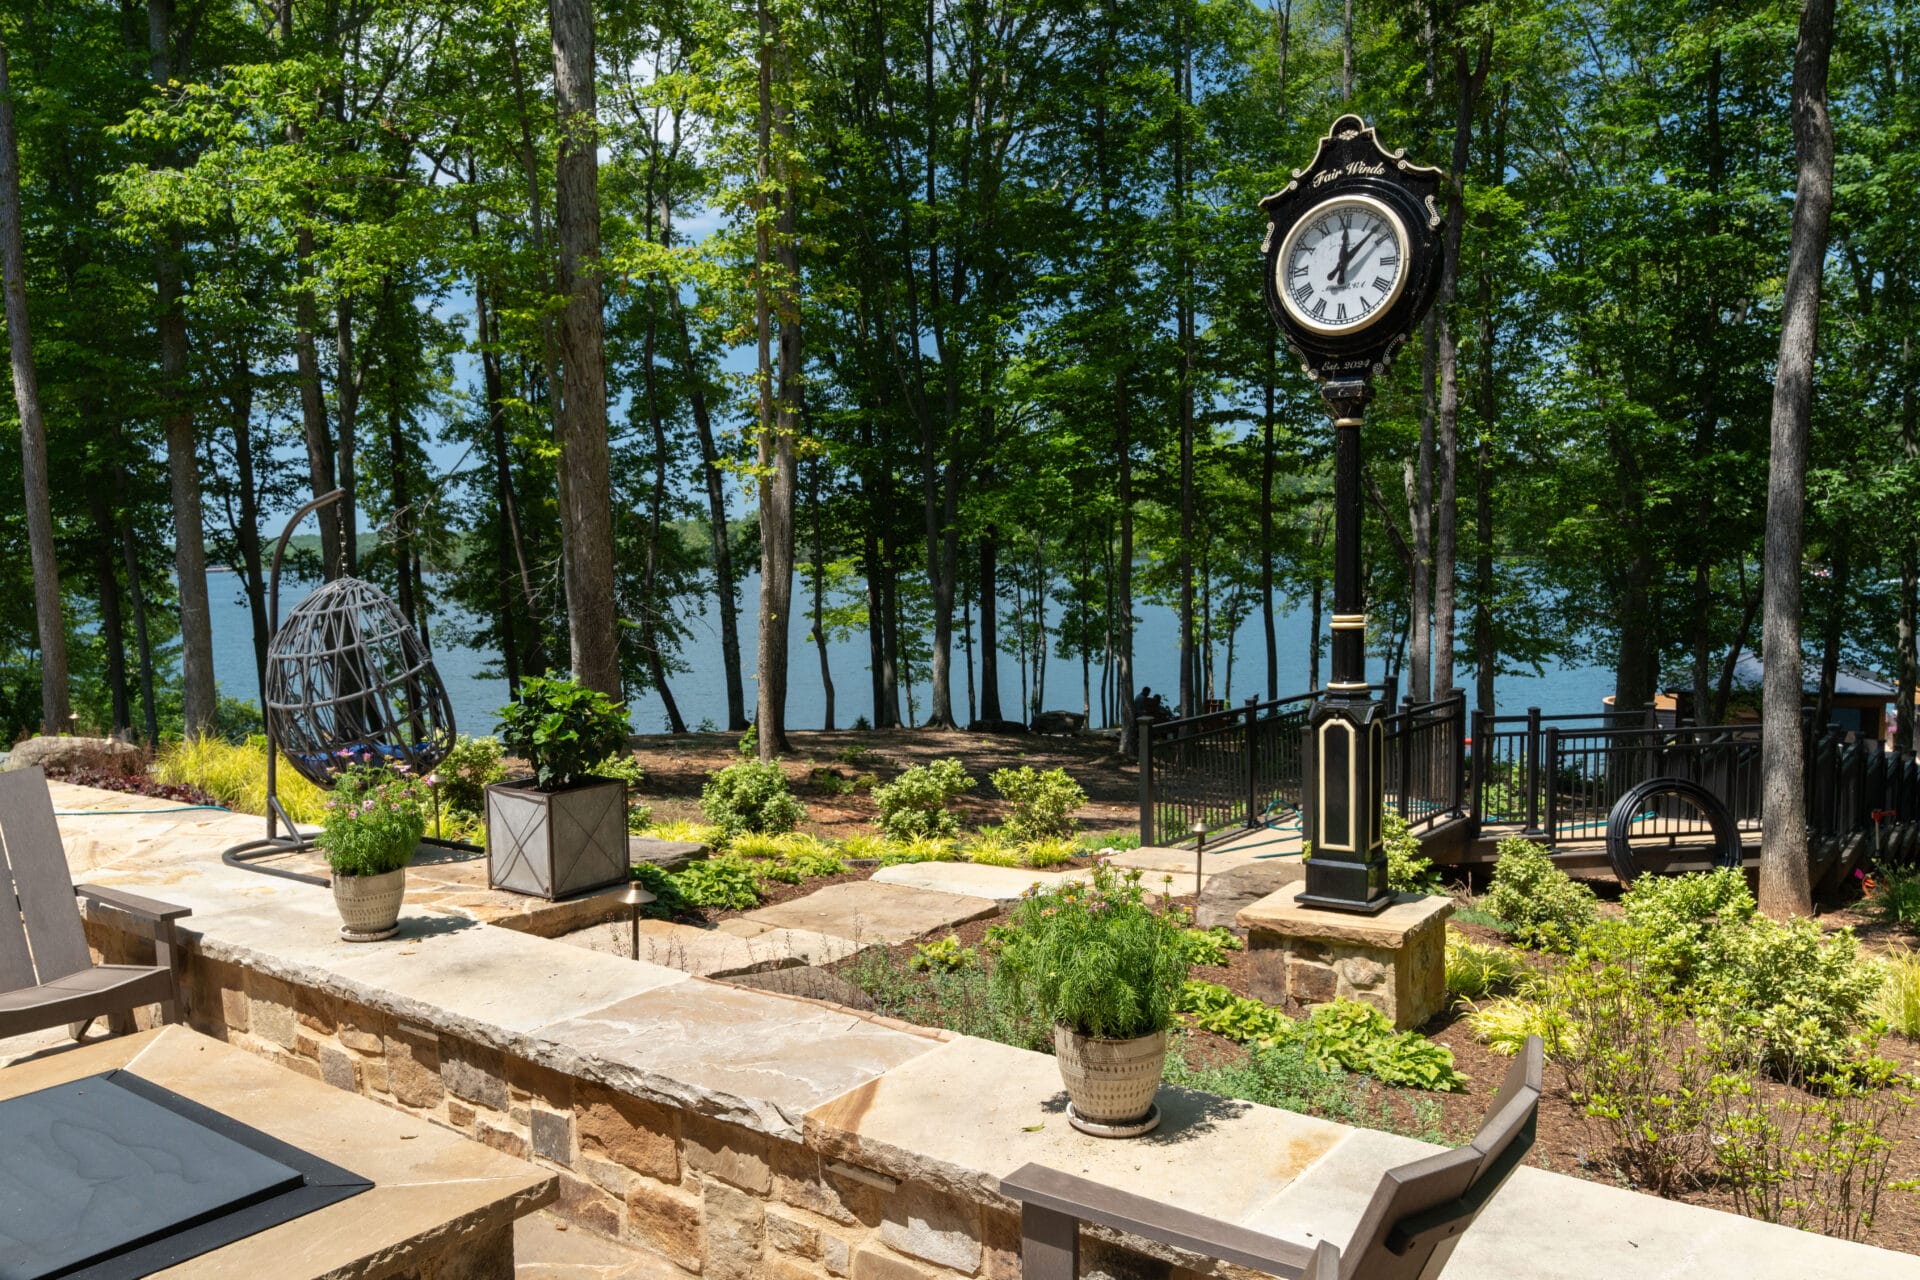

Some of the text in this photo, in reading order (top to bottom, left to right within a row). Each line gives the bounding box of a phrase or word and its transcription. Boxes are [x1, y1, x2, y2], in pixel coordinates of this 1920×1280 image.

[1312, 161, 1385, 188] Fair Winds
[1380, 256, 1396, 266] III
[1343, 359, 1371, 370] 2024
